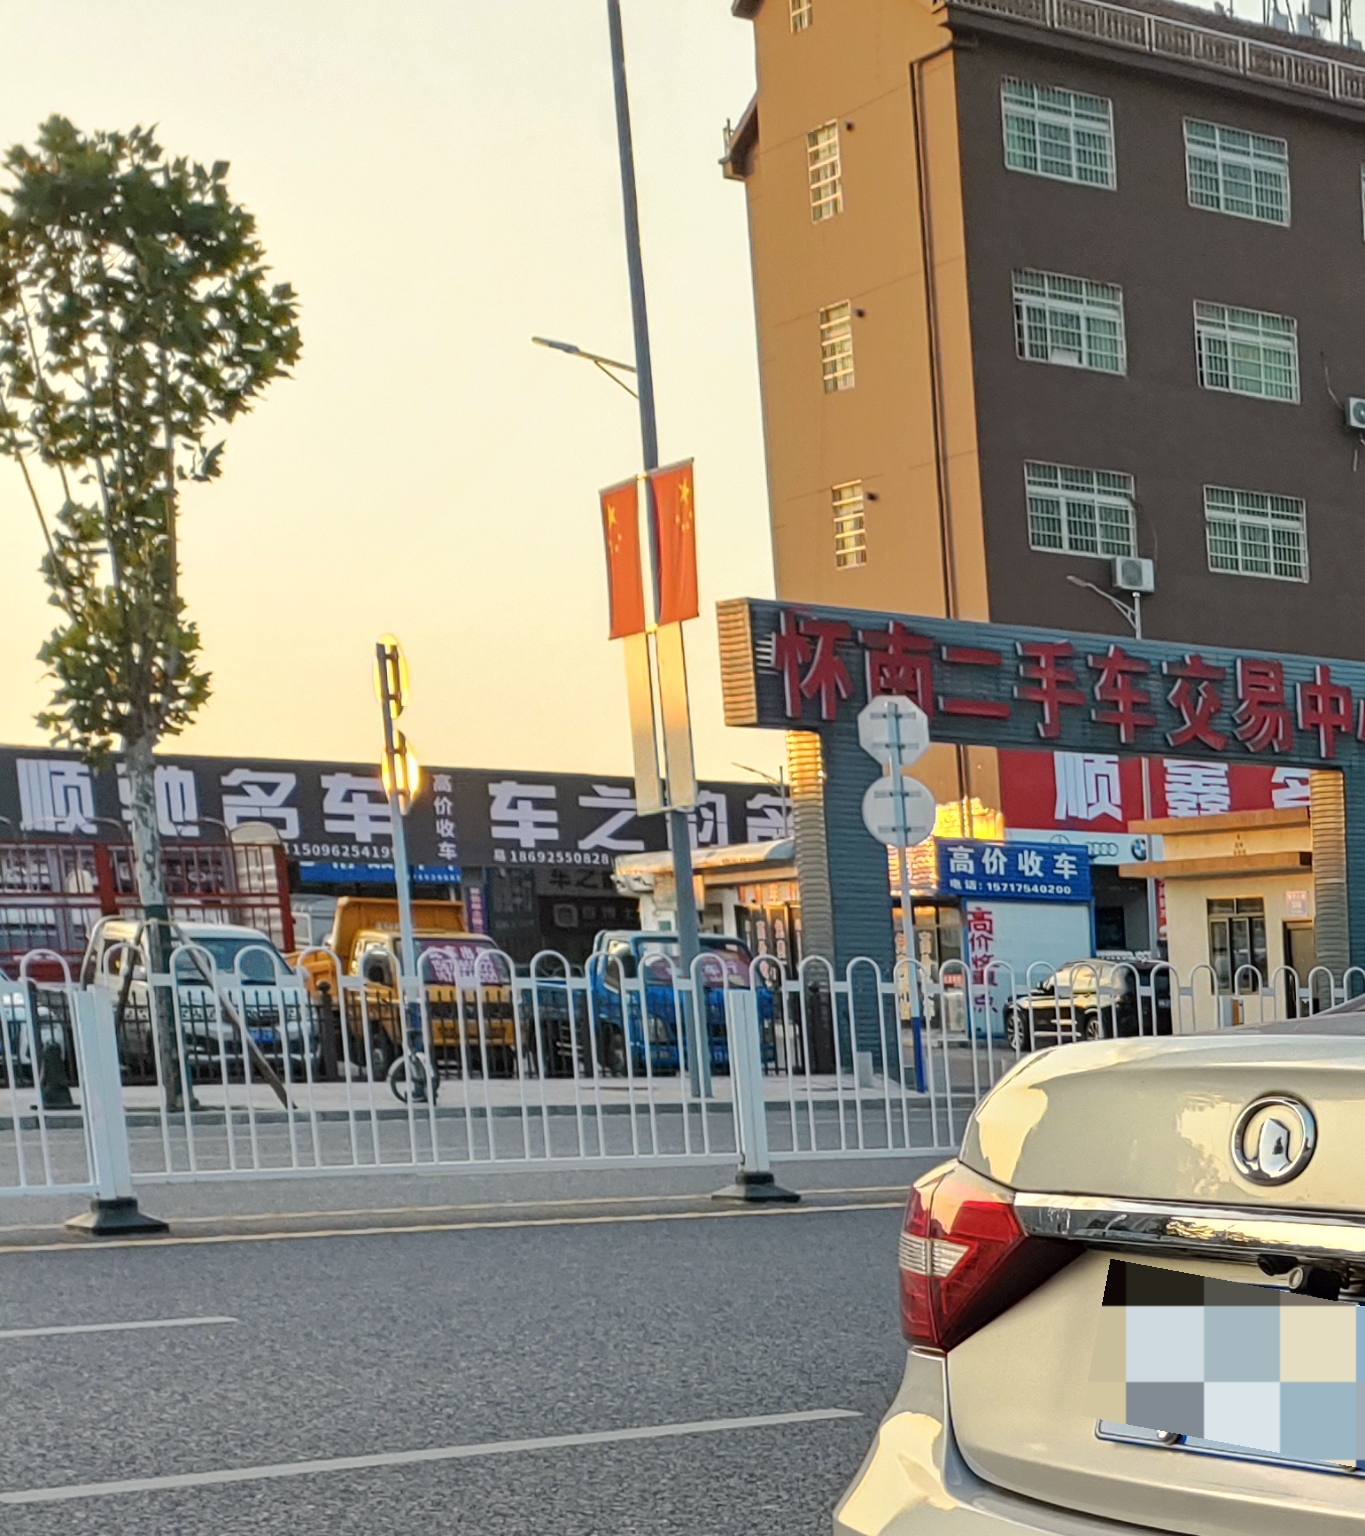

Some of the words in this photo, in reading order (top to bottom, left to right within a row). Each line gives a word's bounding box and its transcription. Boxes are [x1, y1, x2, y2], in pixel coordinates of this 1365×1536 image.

[432, 774, 457, 860] 高价收车
[293, 843, 397, 859] 1509625419
[509, 849, 609, 866] 18692550828
[947, 845, 1079, 880] 高价收车
